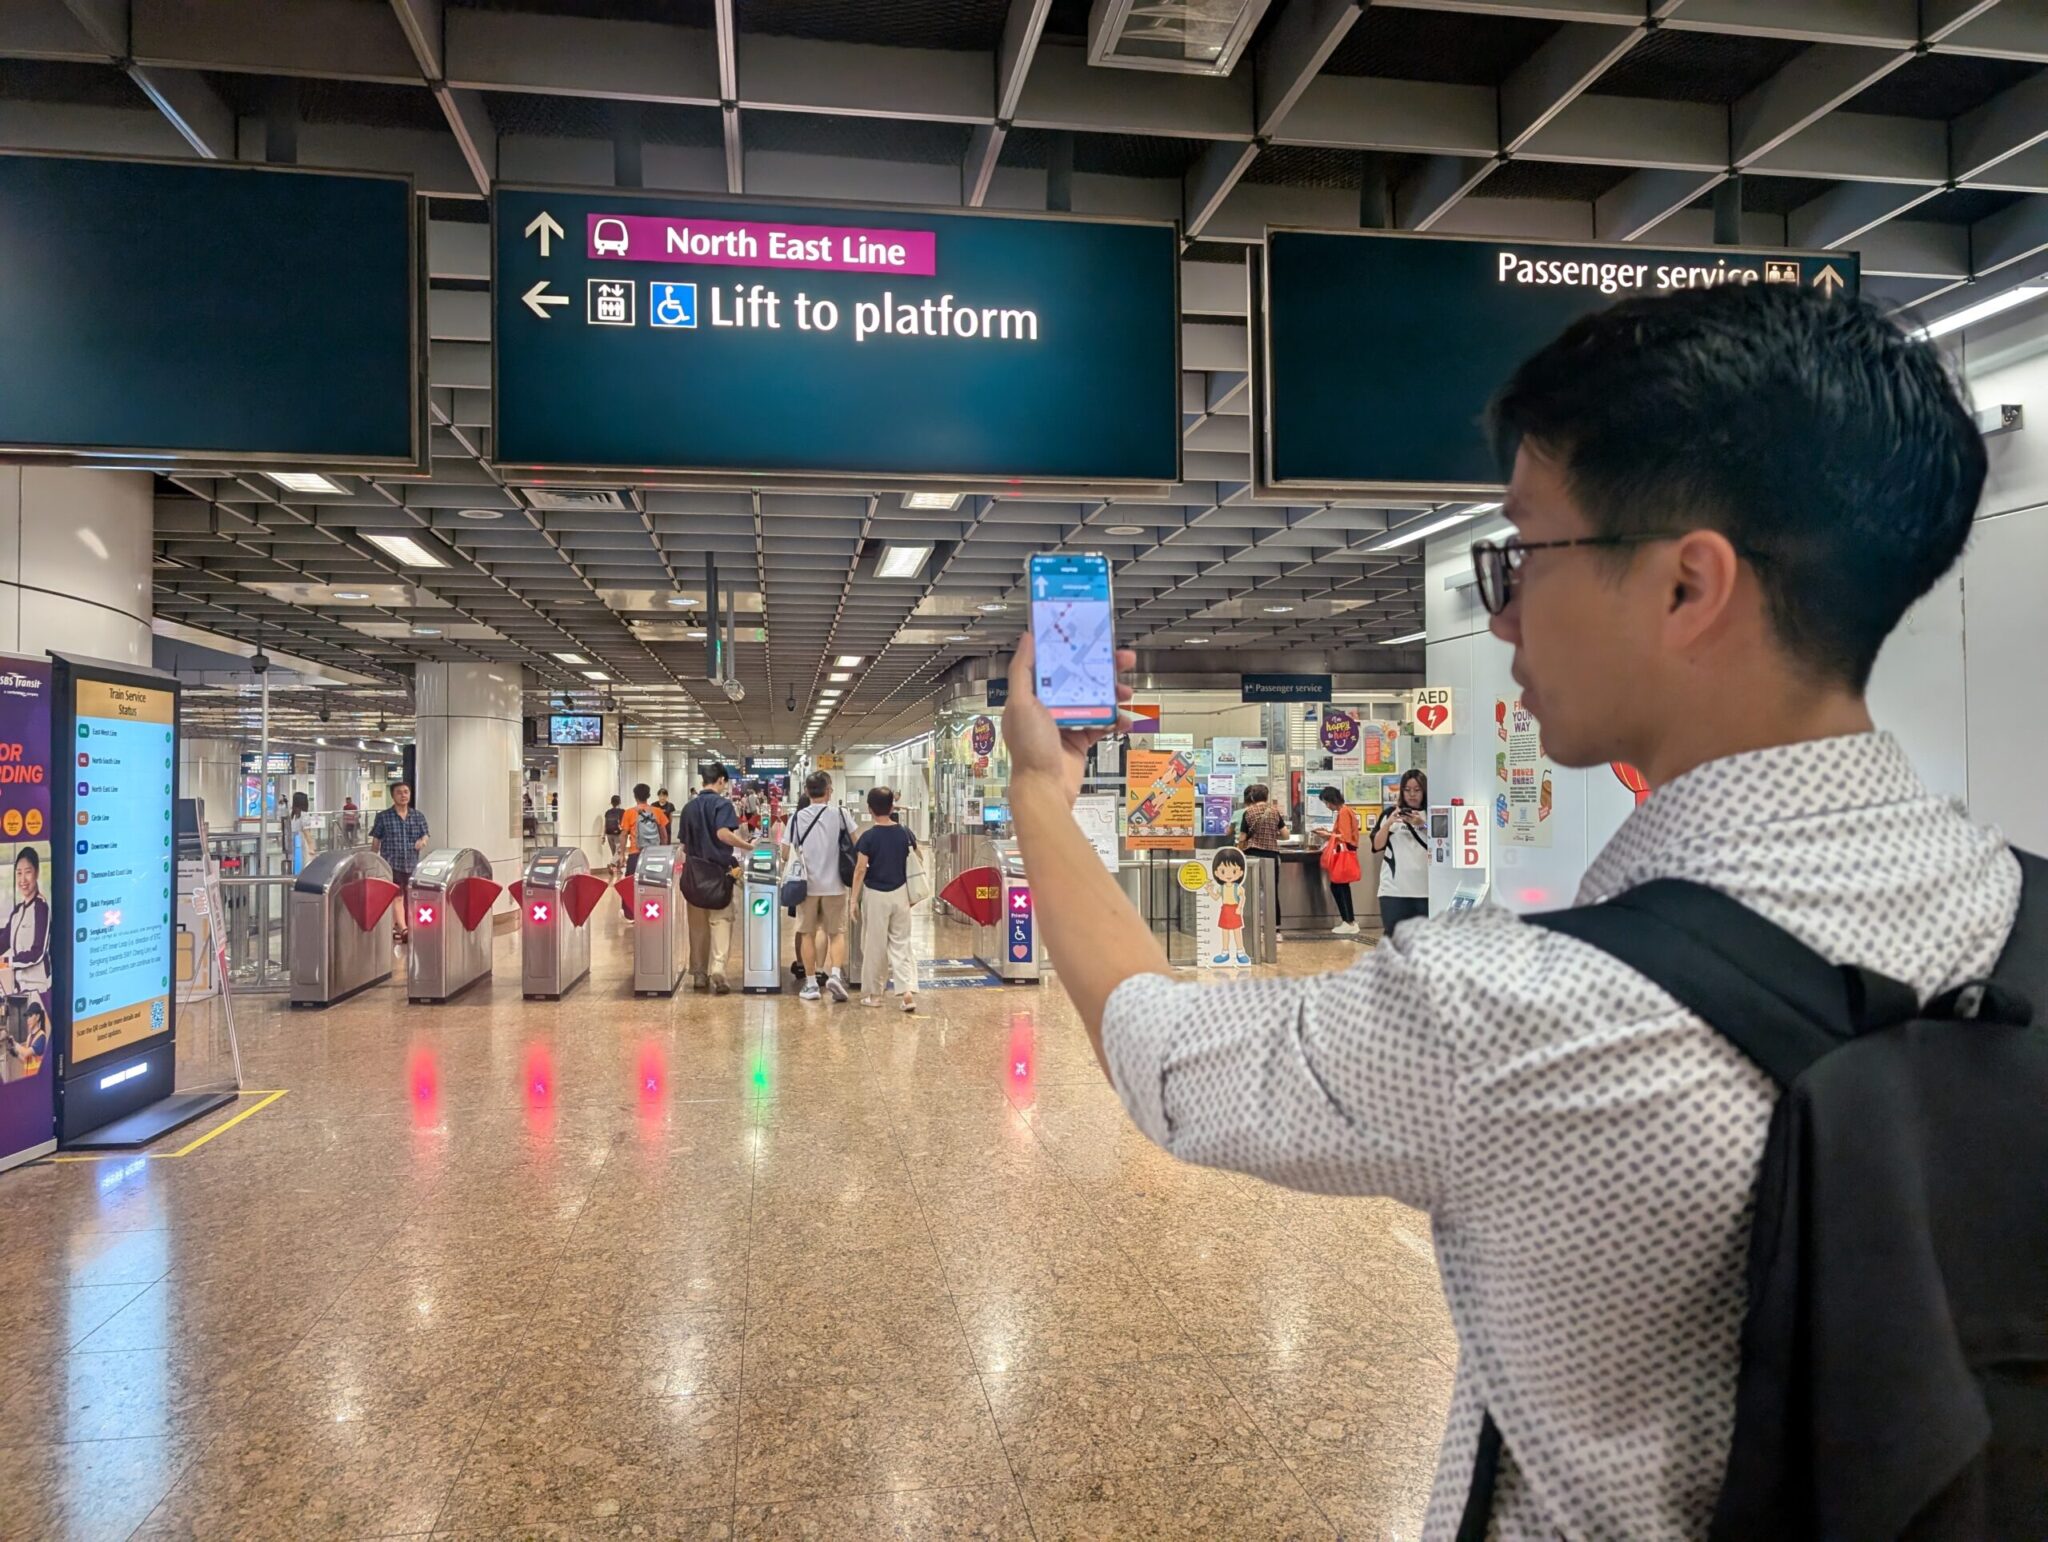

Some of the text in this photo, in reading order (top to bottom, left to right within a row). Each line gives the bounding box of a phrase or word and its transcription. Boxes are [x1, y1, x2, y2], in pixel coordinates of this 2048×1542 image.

[666, 226, 907, 267] North East Line
[1497, 252, 1759, 294] Passenger service
[711, 283, 1038, 343] Lift to platform
[7, 672, 43, 689] Transit
[1255, 683, 1323, 693] Passenger service
[109, 687, 147, 703] Train Service
[1417, 690, 1449, 704] AED
[118, 703, 138, 717] Status
[1512, 710, 1533, 721] YOUR
[1325, 720, 1351, 732] happy
[1514, 721, 1531, 733] WAY
[1333, 730, 1351, 740] help
[0, 765, 43, 783] DING
[1462, 809, 1480, 866] AED
